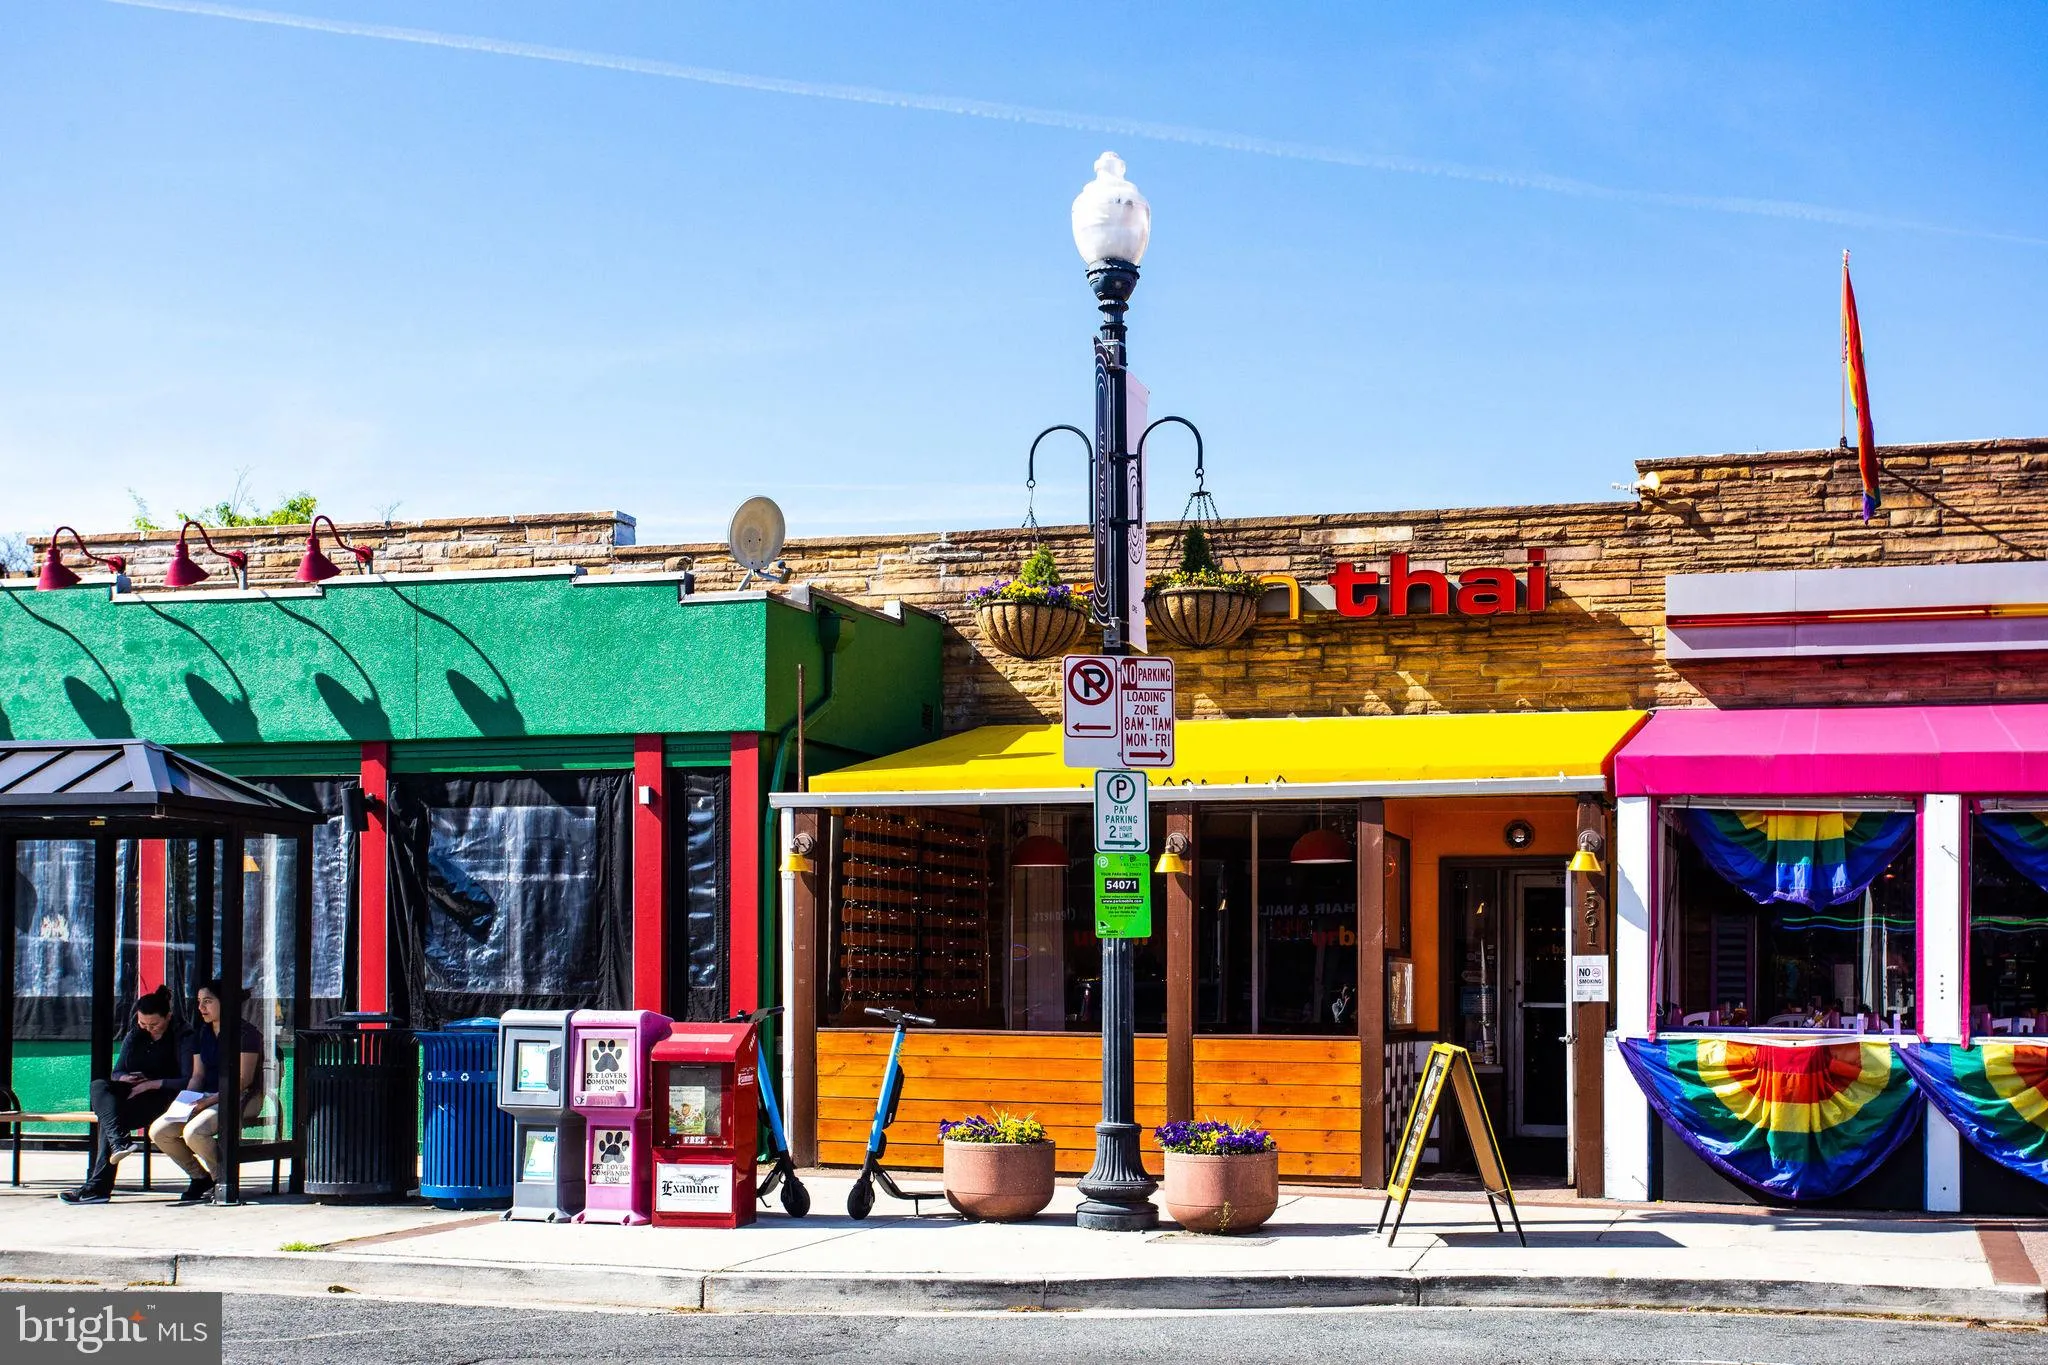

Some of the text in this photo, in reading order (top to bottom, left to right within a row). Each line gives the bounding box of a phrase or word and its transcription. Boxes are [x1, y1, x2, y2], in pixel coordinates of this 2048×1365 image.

[1328, 548, 1546, 617] thai
[1121, 663, 1171, 685] NO PARKING
[1127, 691, 1166, 702] LOADING
[1134, 704, 1159, 716] ZONE
[1124, 716, 1144, 731] 8AM
[1151, 717, 1172, 731] 11AM
[1126, 733, 1147, 747] MON
[1155, 733, 1171, 747] FRI
[1116, 779, 1127, 799] P
[1113, 805, 1129, 815] PAY
[1104, 814, 1138, 824] PARKING
[1109, 825, 1117, 839] 2
[1106, 880, 1137, 890] 54071
[1578, 968, 1591, 977] NO
[683, 1136, 707, 1144] FREE
[606, 1163, 629, 1171] LOVER
[661, 1180, 720, 1197] Examiner
